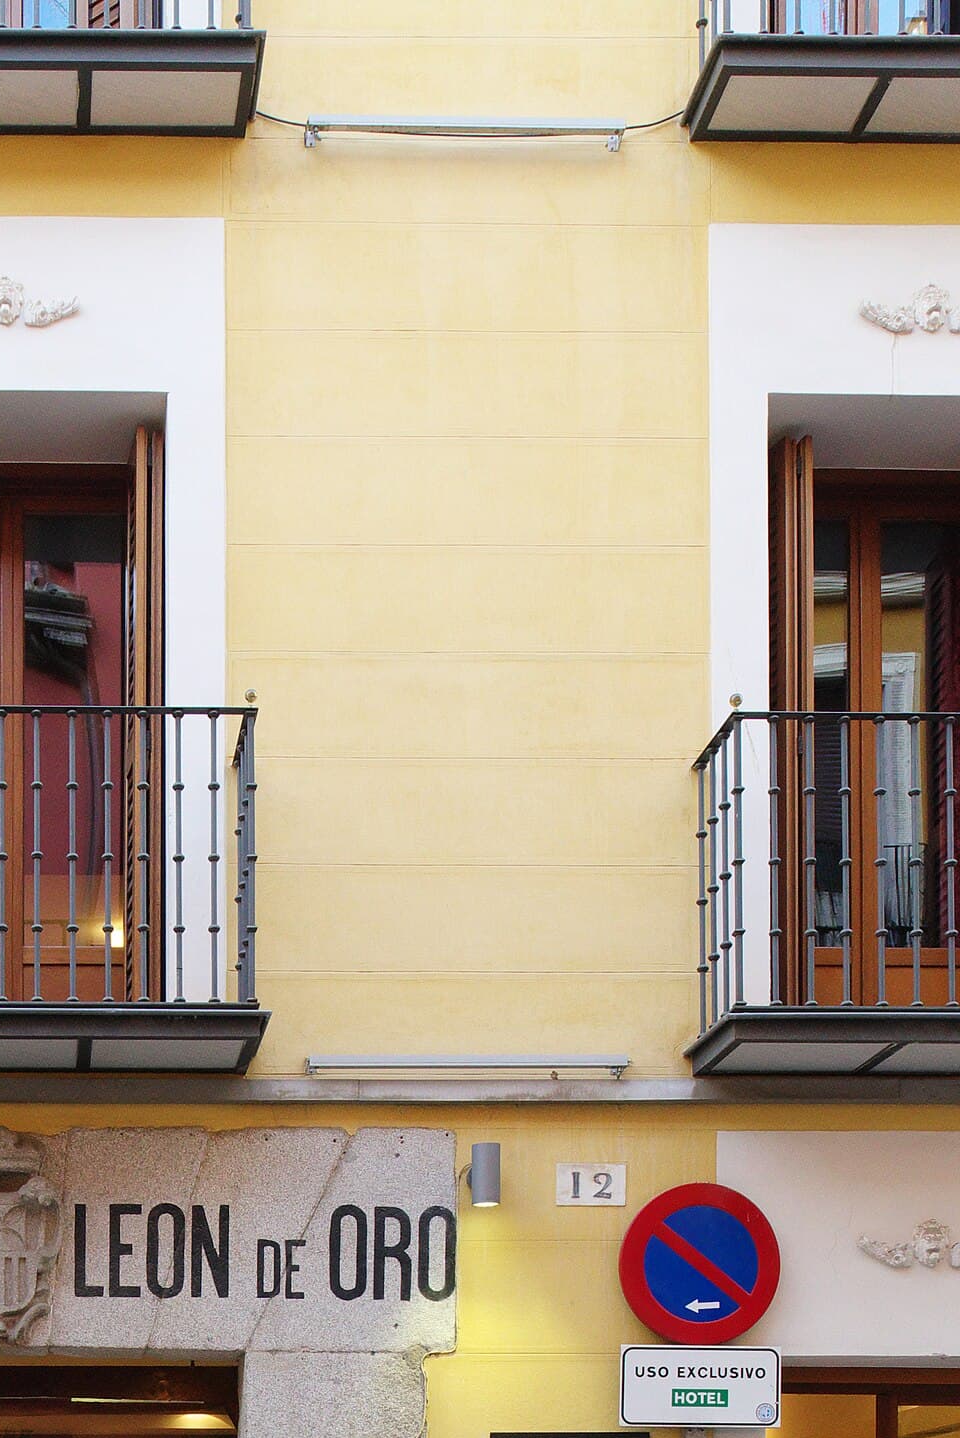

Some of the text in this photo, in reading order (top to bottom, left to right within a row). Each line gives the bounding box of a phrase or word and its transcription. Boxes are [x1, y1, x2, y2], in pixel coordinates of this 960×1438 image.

[571, 1172, 612, 1199] 12
[74, 1204, 229, 1300] LEON
[257, 1239, 307, 1300] DE
[329, 1205, 457, 1302] ORO
[635, 1367, 766, 1378] USO EXCLUSIVO
[675, 1393, 725, 1404] HOTEL
